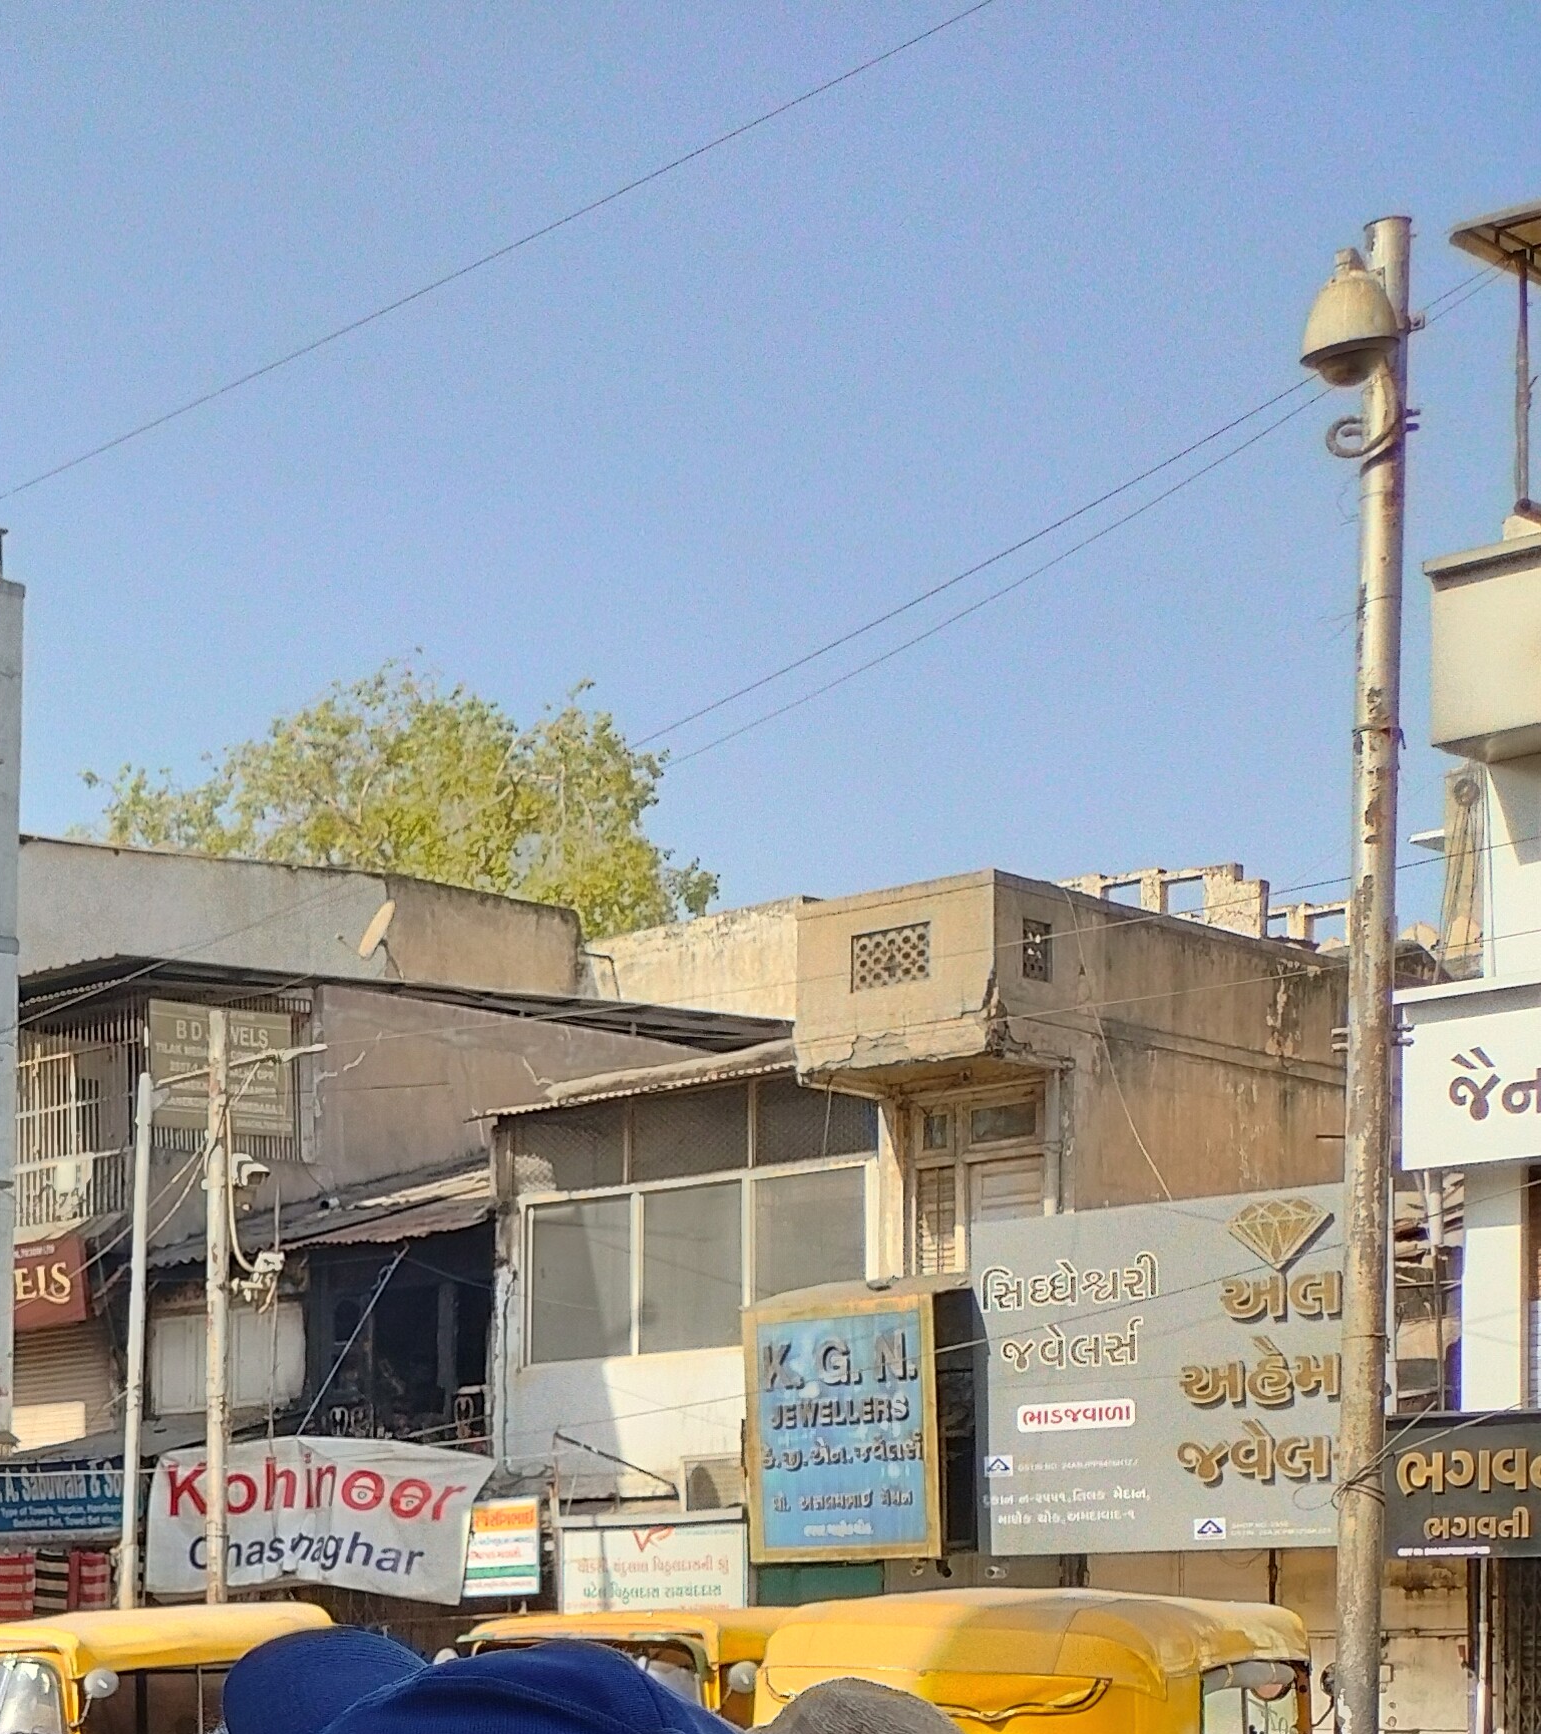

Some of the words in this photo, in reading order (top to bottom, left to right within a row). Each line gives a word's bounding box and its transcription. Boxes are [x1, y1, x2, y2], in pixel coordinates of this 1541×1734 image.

[1179, 1335, 1341, 1408] અહેમ
[771, 1396, 910, 1430] JEWELLERS
[1022, 1405, 1131, 1426] ભાડજવાળા
[1177, 1418, 1339, 1486] જવેલ
[20, 1464, 87, 1500] Sabuwala
[88, 1460, 101, 1498] &
[103, 1460, 124, 1498] So
[167, 1454, 466, 1522] Kohinoor
[1424, 1506, 1531, 1541] ભગવતી
